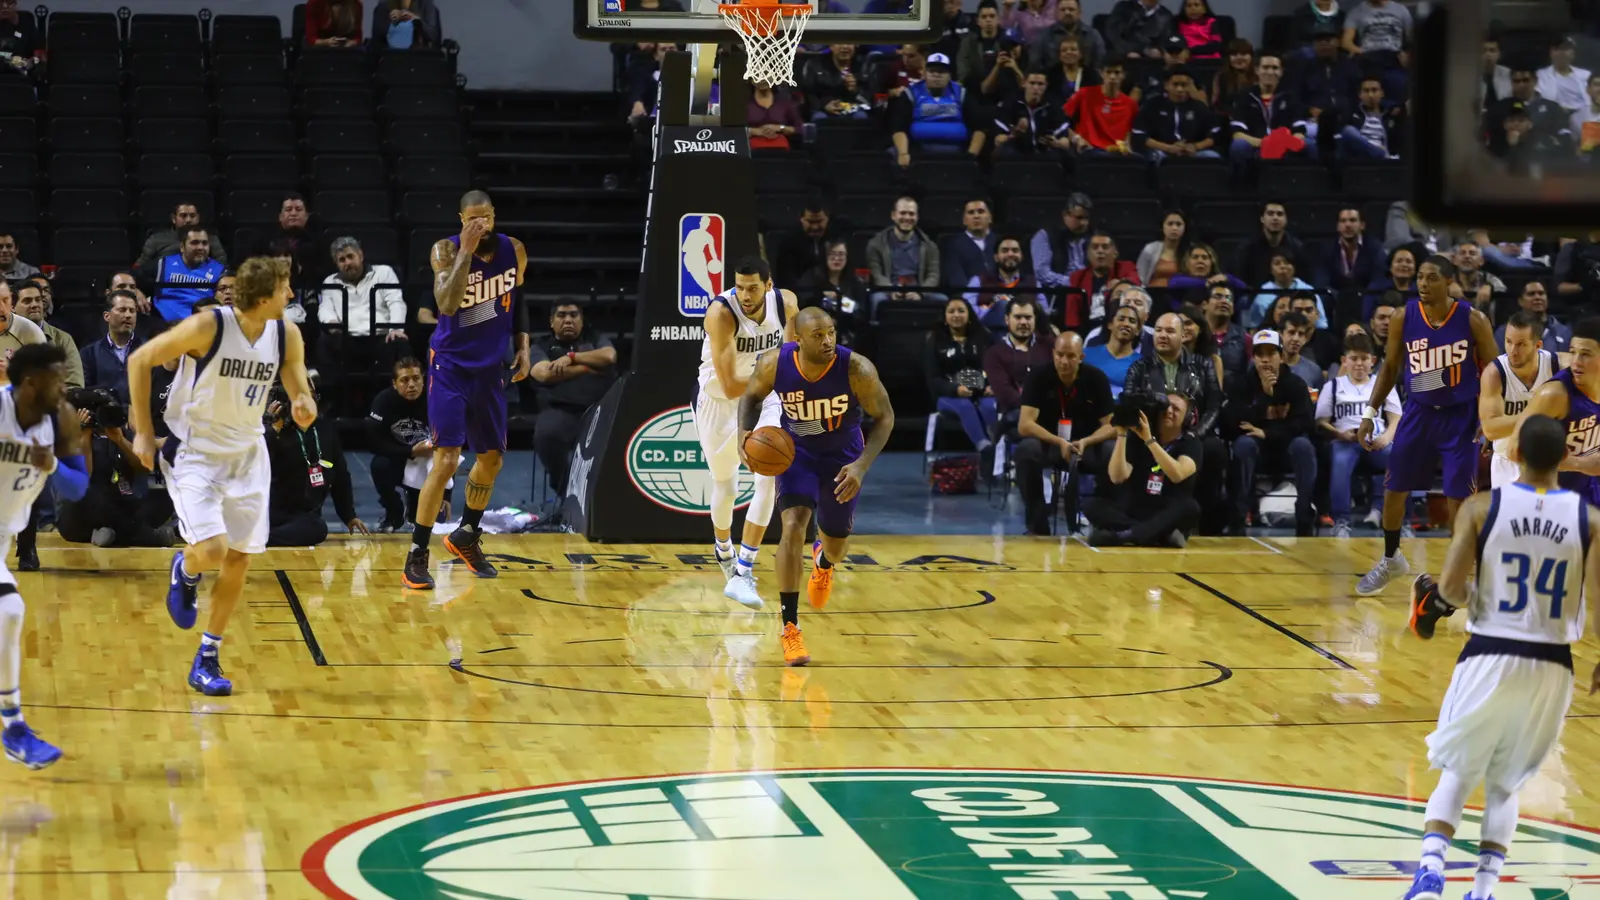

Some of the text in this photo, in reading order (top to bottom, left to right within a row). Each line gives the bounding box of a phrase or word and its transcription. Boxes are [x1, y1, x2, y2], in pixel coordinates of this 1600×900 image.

[598, 19, 631, 27] SPALDING
[674, 139, 736, 154] SPALDING
[468, 270, 484, 285] OS
[500, 292, 512, 313] 4
[684, 295, 708, 309] NBA
[736, 330, 780, 353] DALLAS
[1406, 338, 1429, 353] LOS
[219, 357, 274, 381] DALLAS
[245, 383, 267, 407] 41
[779, 390, 805, 403] LOS
[1569, 414, 1597, 433] LOS
[641, 450, 669, 462] CD.
[673, 450, 697, 462] DE
[1510, 517, 1568, 544] HARRIS
[1498, 552, 1568, 619] 34
[910, 787, 1060, 821] CD.
[950, 827, 1119, 858] DE
